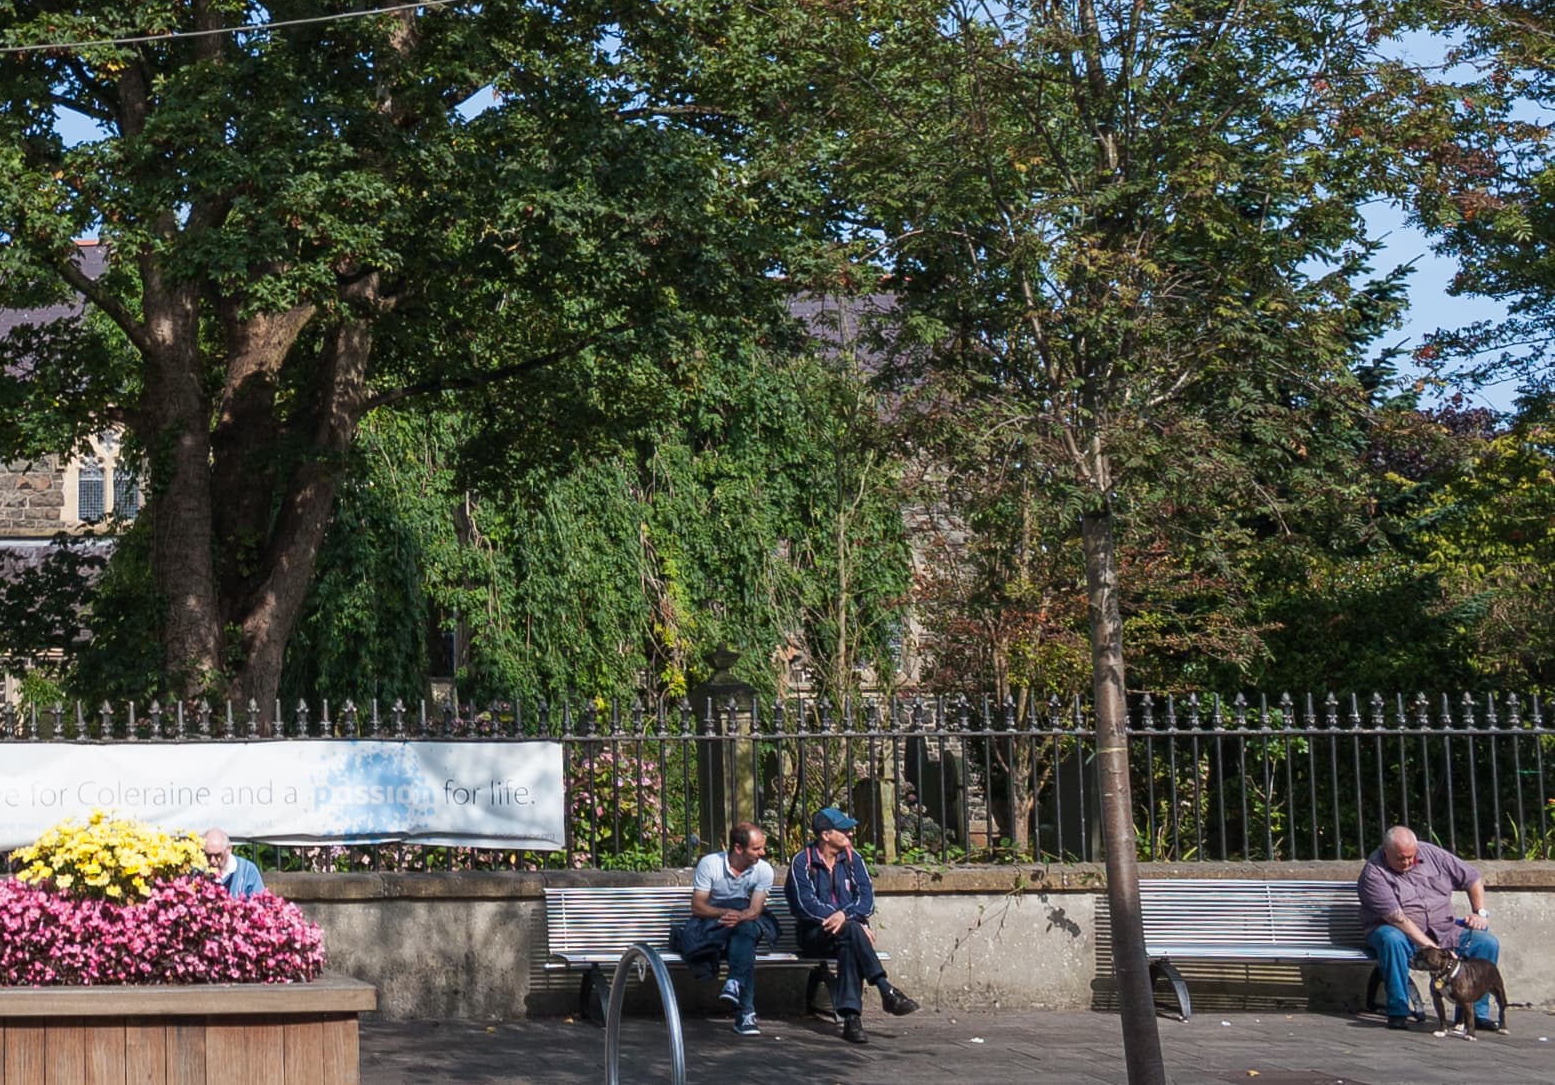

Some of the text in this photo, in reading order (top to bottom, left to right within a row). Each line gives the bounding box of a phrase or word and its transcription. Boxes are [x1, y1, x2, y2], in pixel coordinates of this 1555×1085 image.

[30, 780, 68, 807] for
[77, 780, 210, 807] Coleraine
[221, 779, 273, 805] and
[284, 785, 298, 805] a
[314, 784, 436, 811] passion
[443, 778, 481, 806] for
[490, 779, 537, 806] life.
